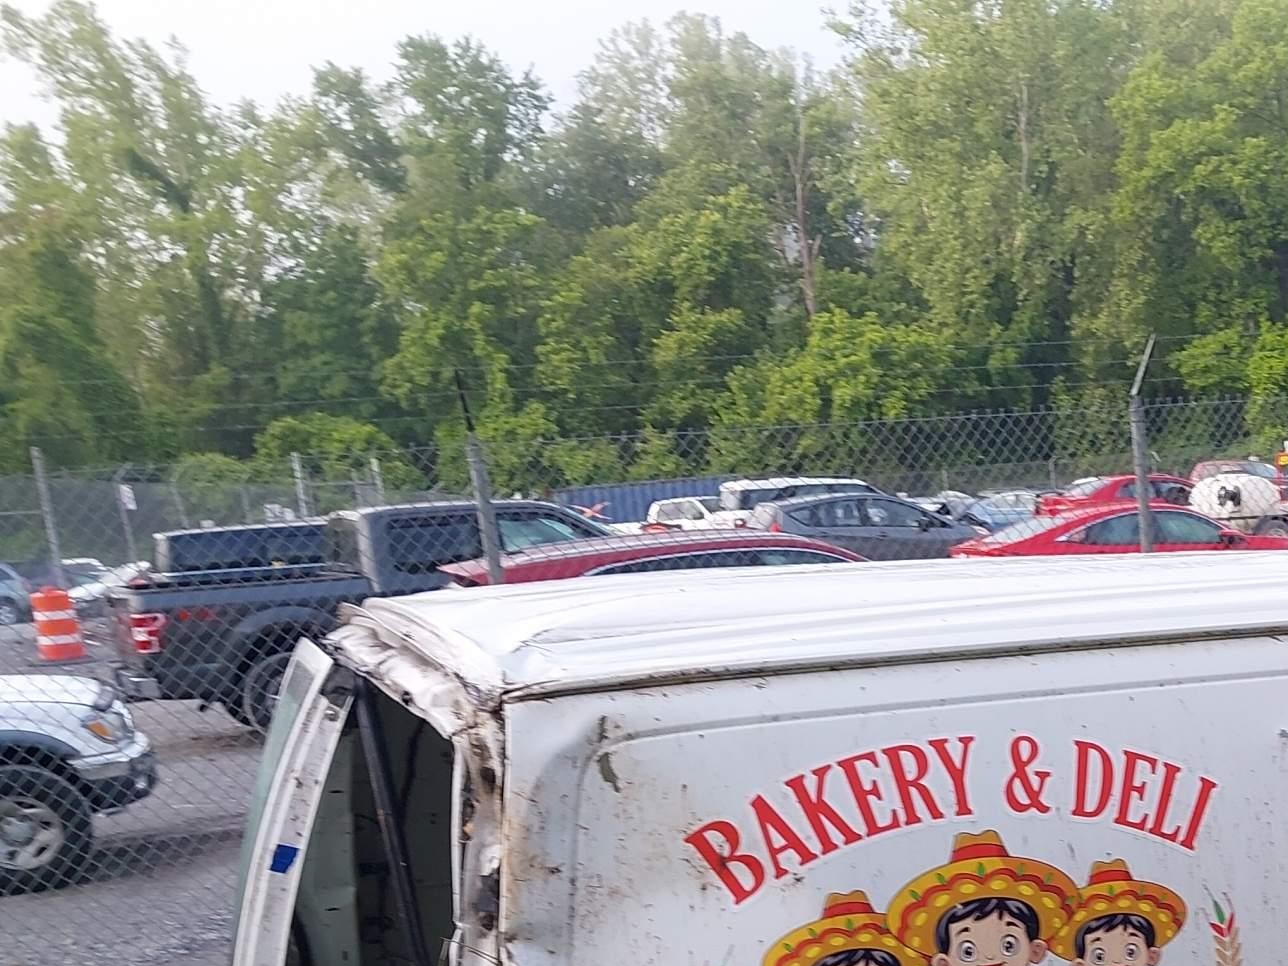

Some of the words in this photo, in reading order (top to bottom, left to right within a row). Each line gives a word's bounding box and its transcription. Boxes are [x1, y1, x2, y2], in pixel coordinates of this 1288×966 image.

[684, 736, 974, 904] BAKERY
[1004, 735, 1051, 815] &
[1072, 740, 1218, 851] DELI
